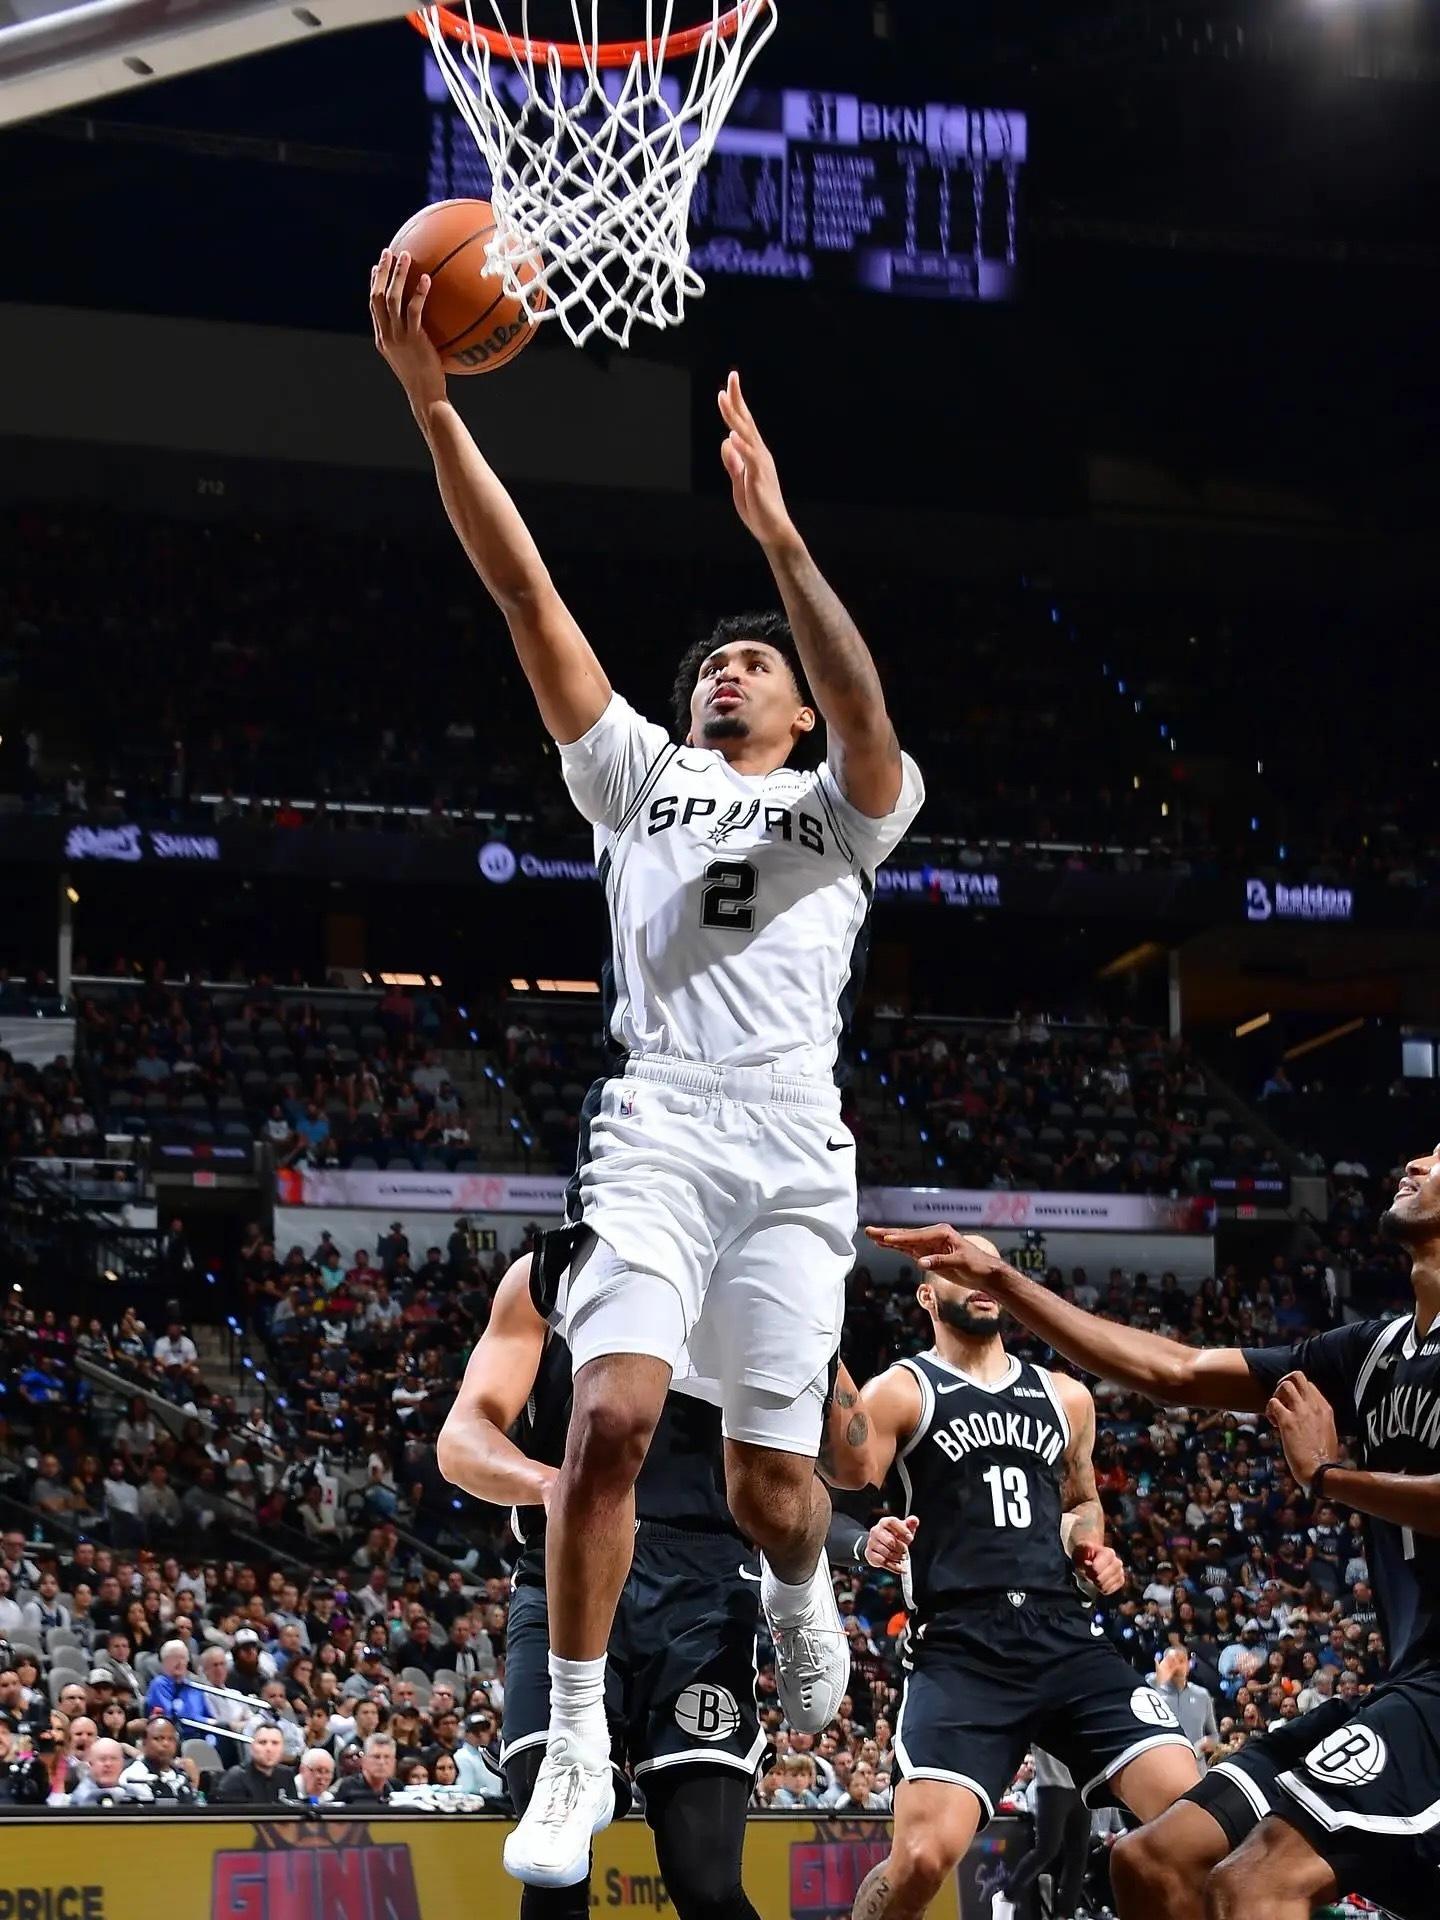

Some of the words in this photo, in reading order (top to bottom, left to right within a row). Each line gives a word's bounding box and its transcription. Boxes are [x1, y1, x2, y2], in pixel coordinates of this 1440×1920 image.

[861, 102, 924, 146] BKN
[648, 796, 825, 857] SPURS
[700, 858, 759, 932] 2
[1013, 1251, 1045, 1268] 112
[932, 1410, 1064, 1466] BROOKLYN
[982, 1464, 1032, 1529] 13
[698, 1690, 720, 1733] B
[1146, 1693, 1170, 1721] B
[1315, 1733, 1371, 1773] B
[214, 1846, 419, 1920] GUNN
